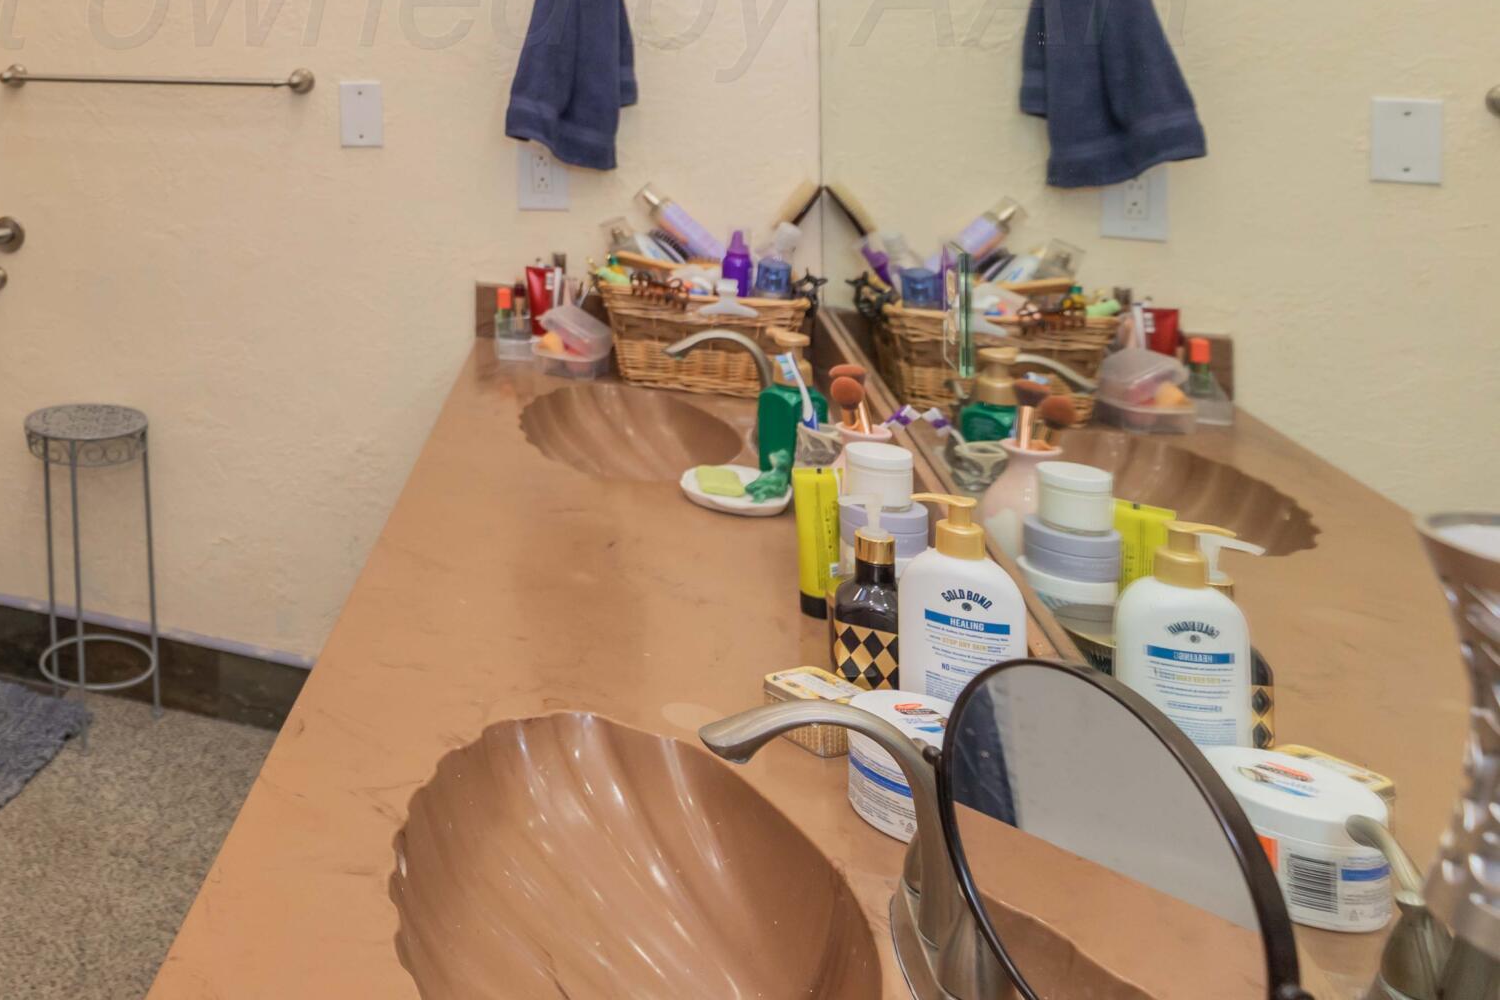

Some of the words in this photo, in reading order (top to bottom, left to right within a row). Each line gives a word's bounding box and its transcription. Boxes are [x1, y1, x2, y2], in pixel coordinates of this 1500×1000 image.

[941, 589, 965, 602] GOLD
[966, 590, 993, 610] BOND
[949, 617, 985, 632] HEALING
[941, 662, 950, 671] NO
